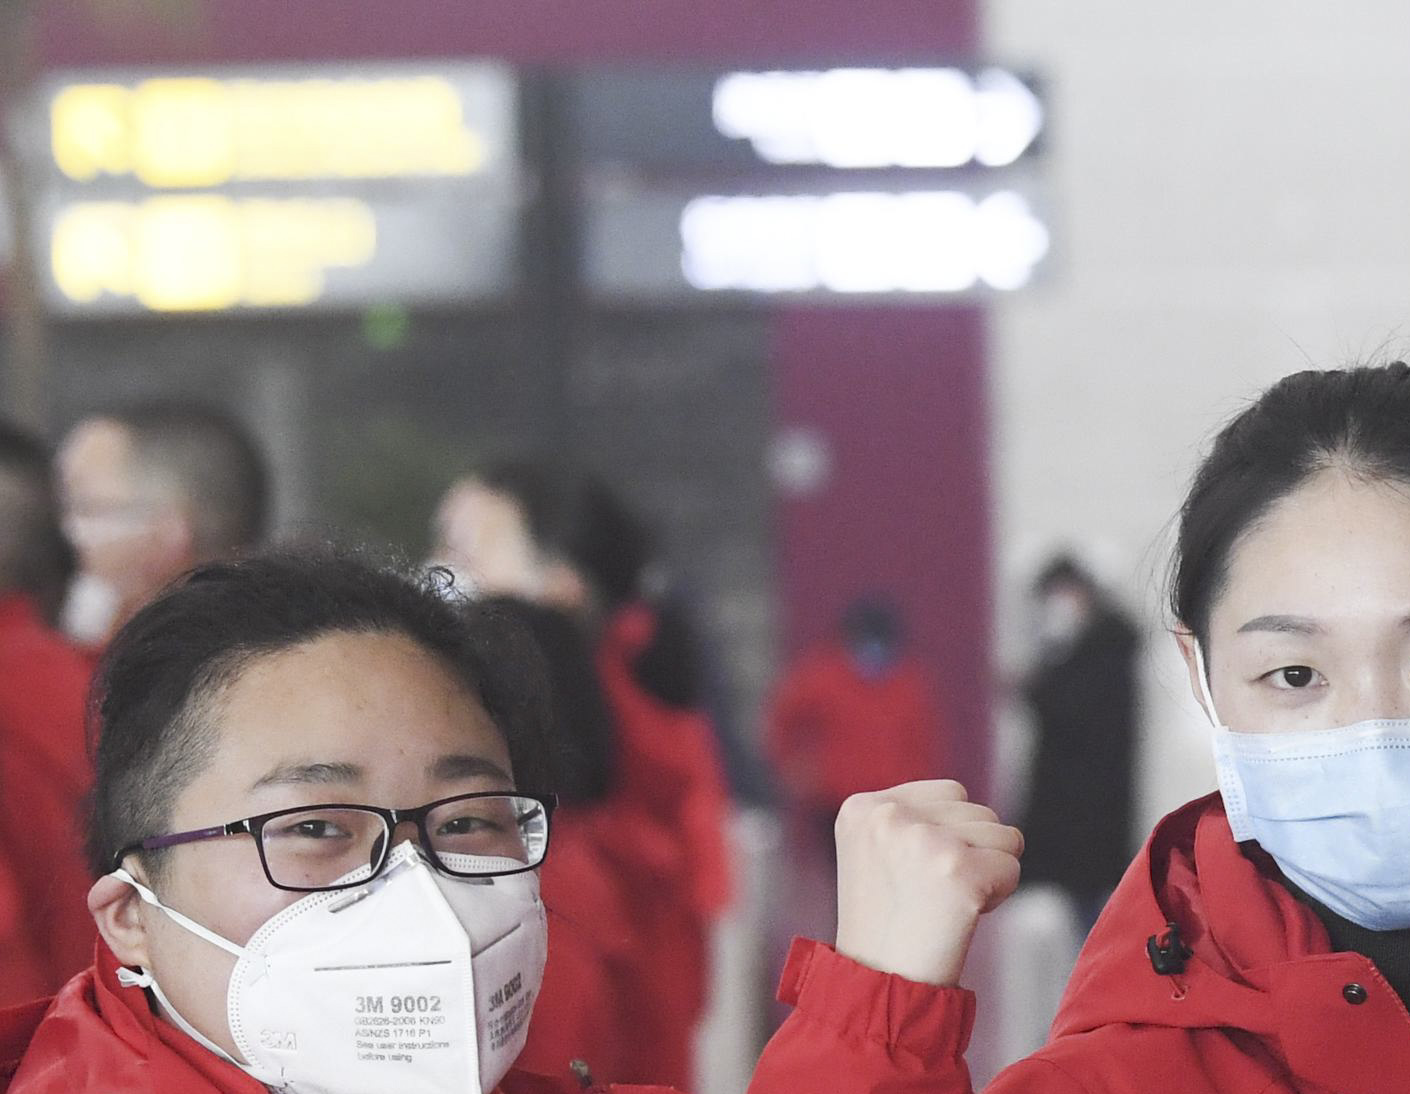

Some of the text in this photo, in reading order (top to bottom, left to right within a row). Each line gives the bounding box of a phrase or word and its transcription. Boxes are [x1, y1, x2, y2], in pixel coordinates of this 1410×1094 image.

[355, 995, 442, 1013] 3M 9002
[418, 1028, 431, 1038] P1
[356, 1040, 450, 1050] See user instructions
[357, 1051, 413, 1063] before using
